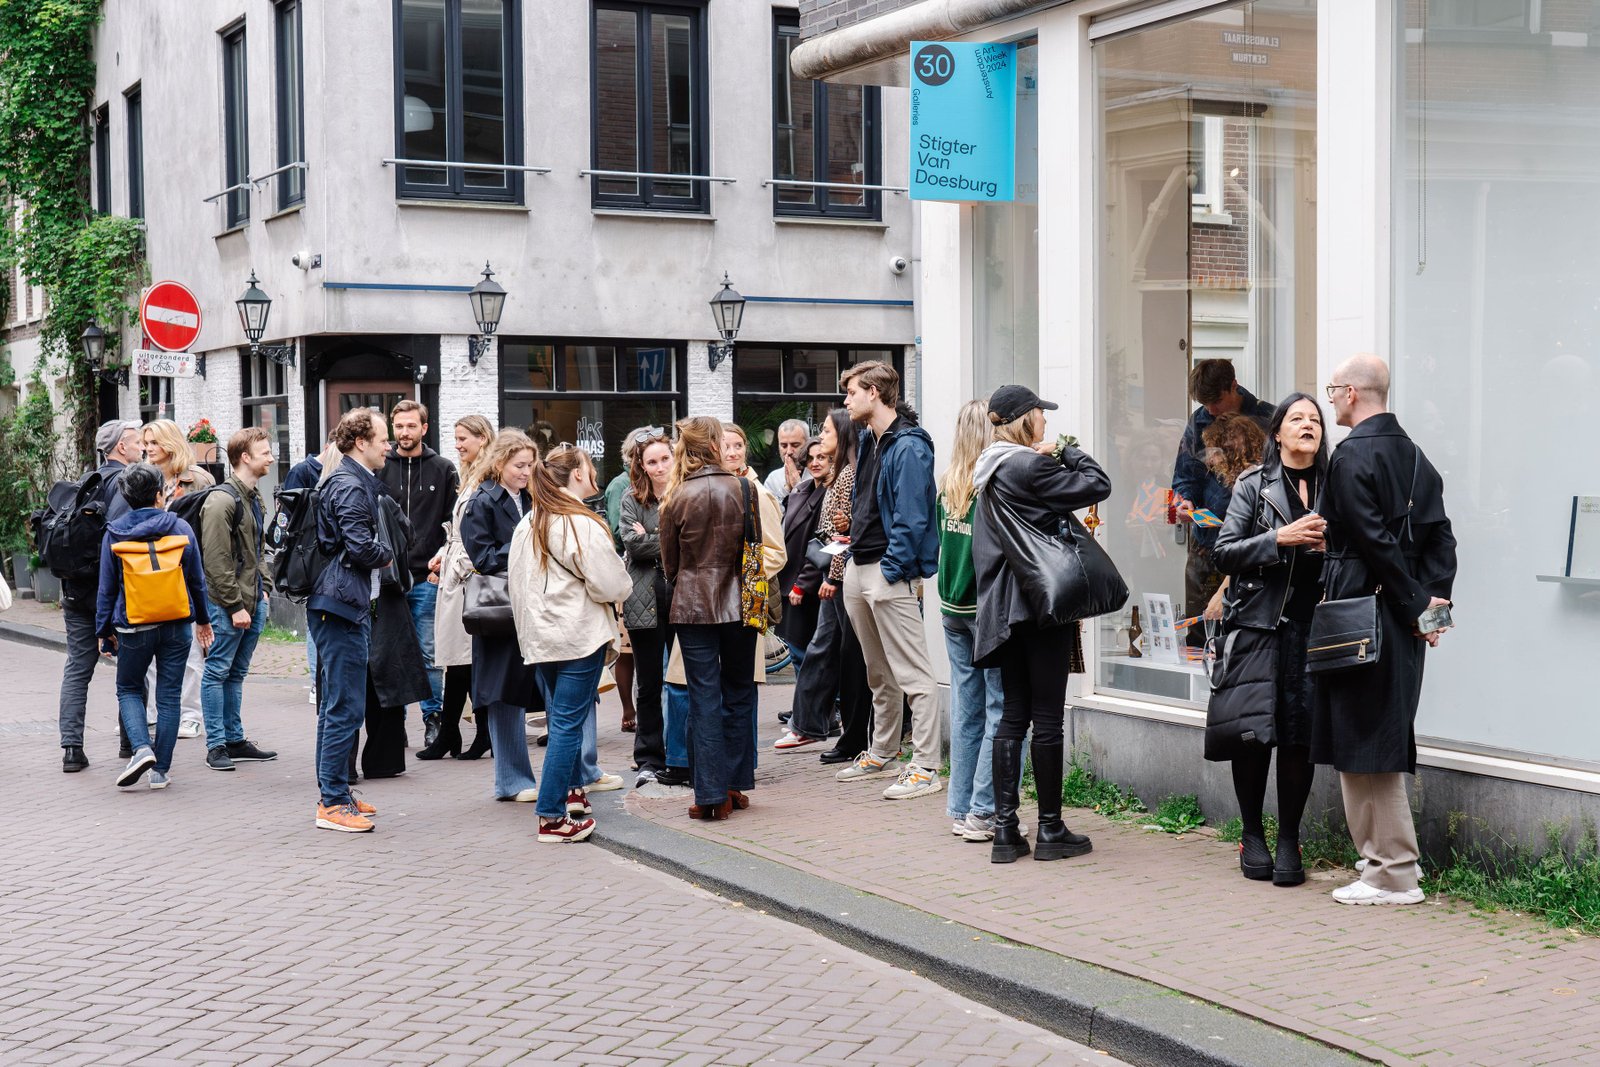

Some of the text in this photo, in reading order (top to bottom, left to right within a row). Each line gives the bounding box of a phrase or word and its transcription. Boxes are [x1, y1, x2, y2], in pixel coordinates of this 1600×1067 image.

[982, 46, 996, 55] Art
[984, 51, 1007, 63] Week
[919, 53, 951, 77] 30
[975, 49, 994, 98] Amsterdam
[986, 61, 1007, 72] 2024
[919, 134, 977, 155] Stigter
[918, 151, 950, 170] Van
[915, 169, 997, 197] Doesburg
[139, 353, 190, 361] uitgezonderd
[449, 364, 479, 382] 121
[947, 519, 972, 535] SCHOOL
